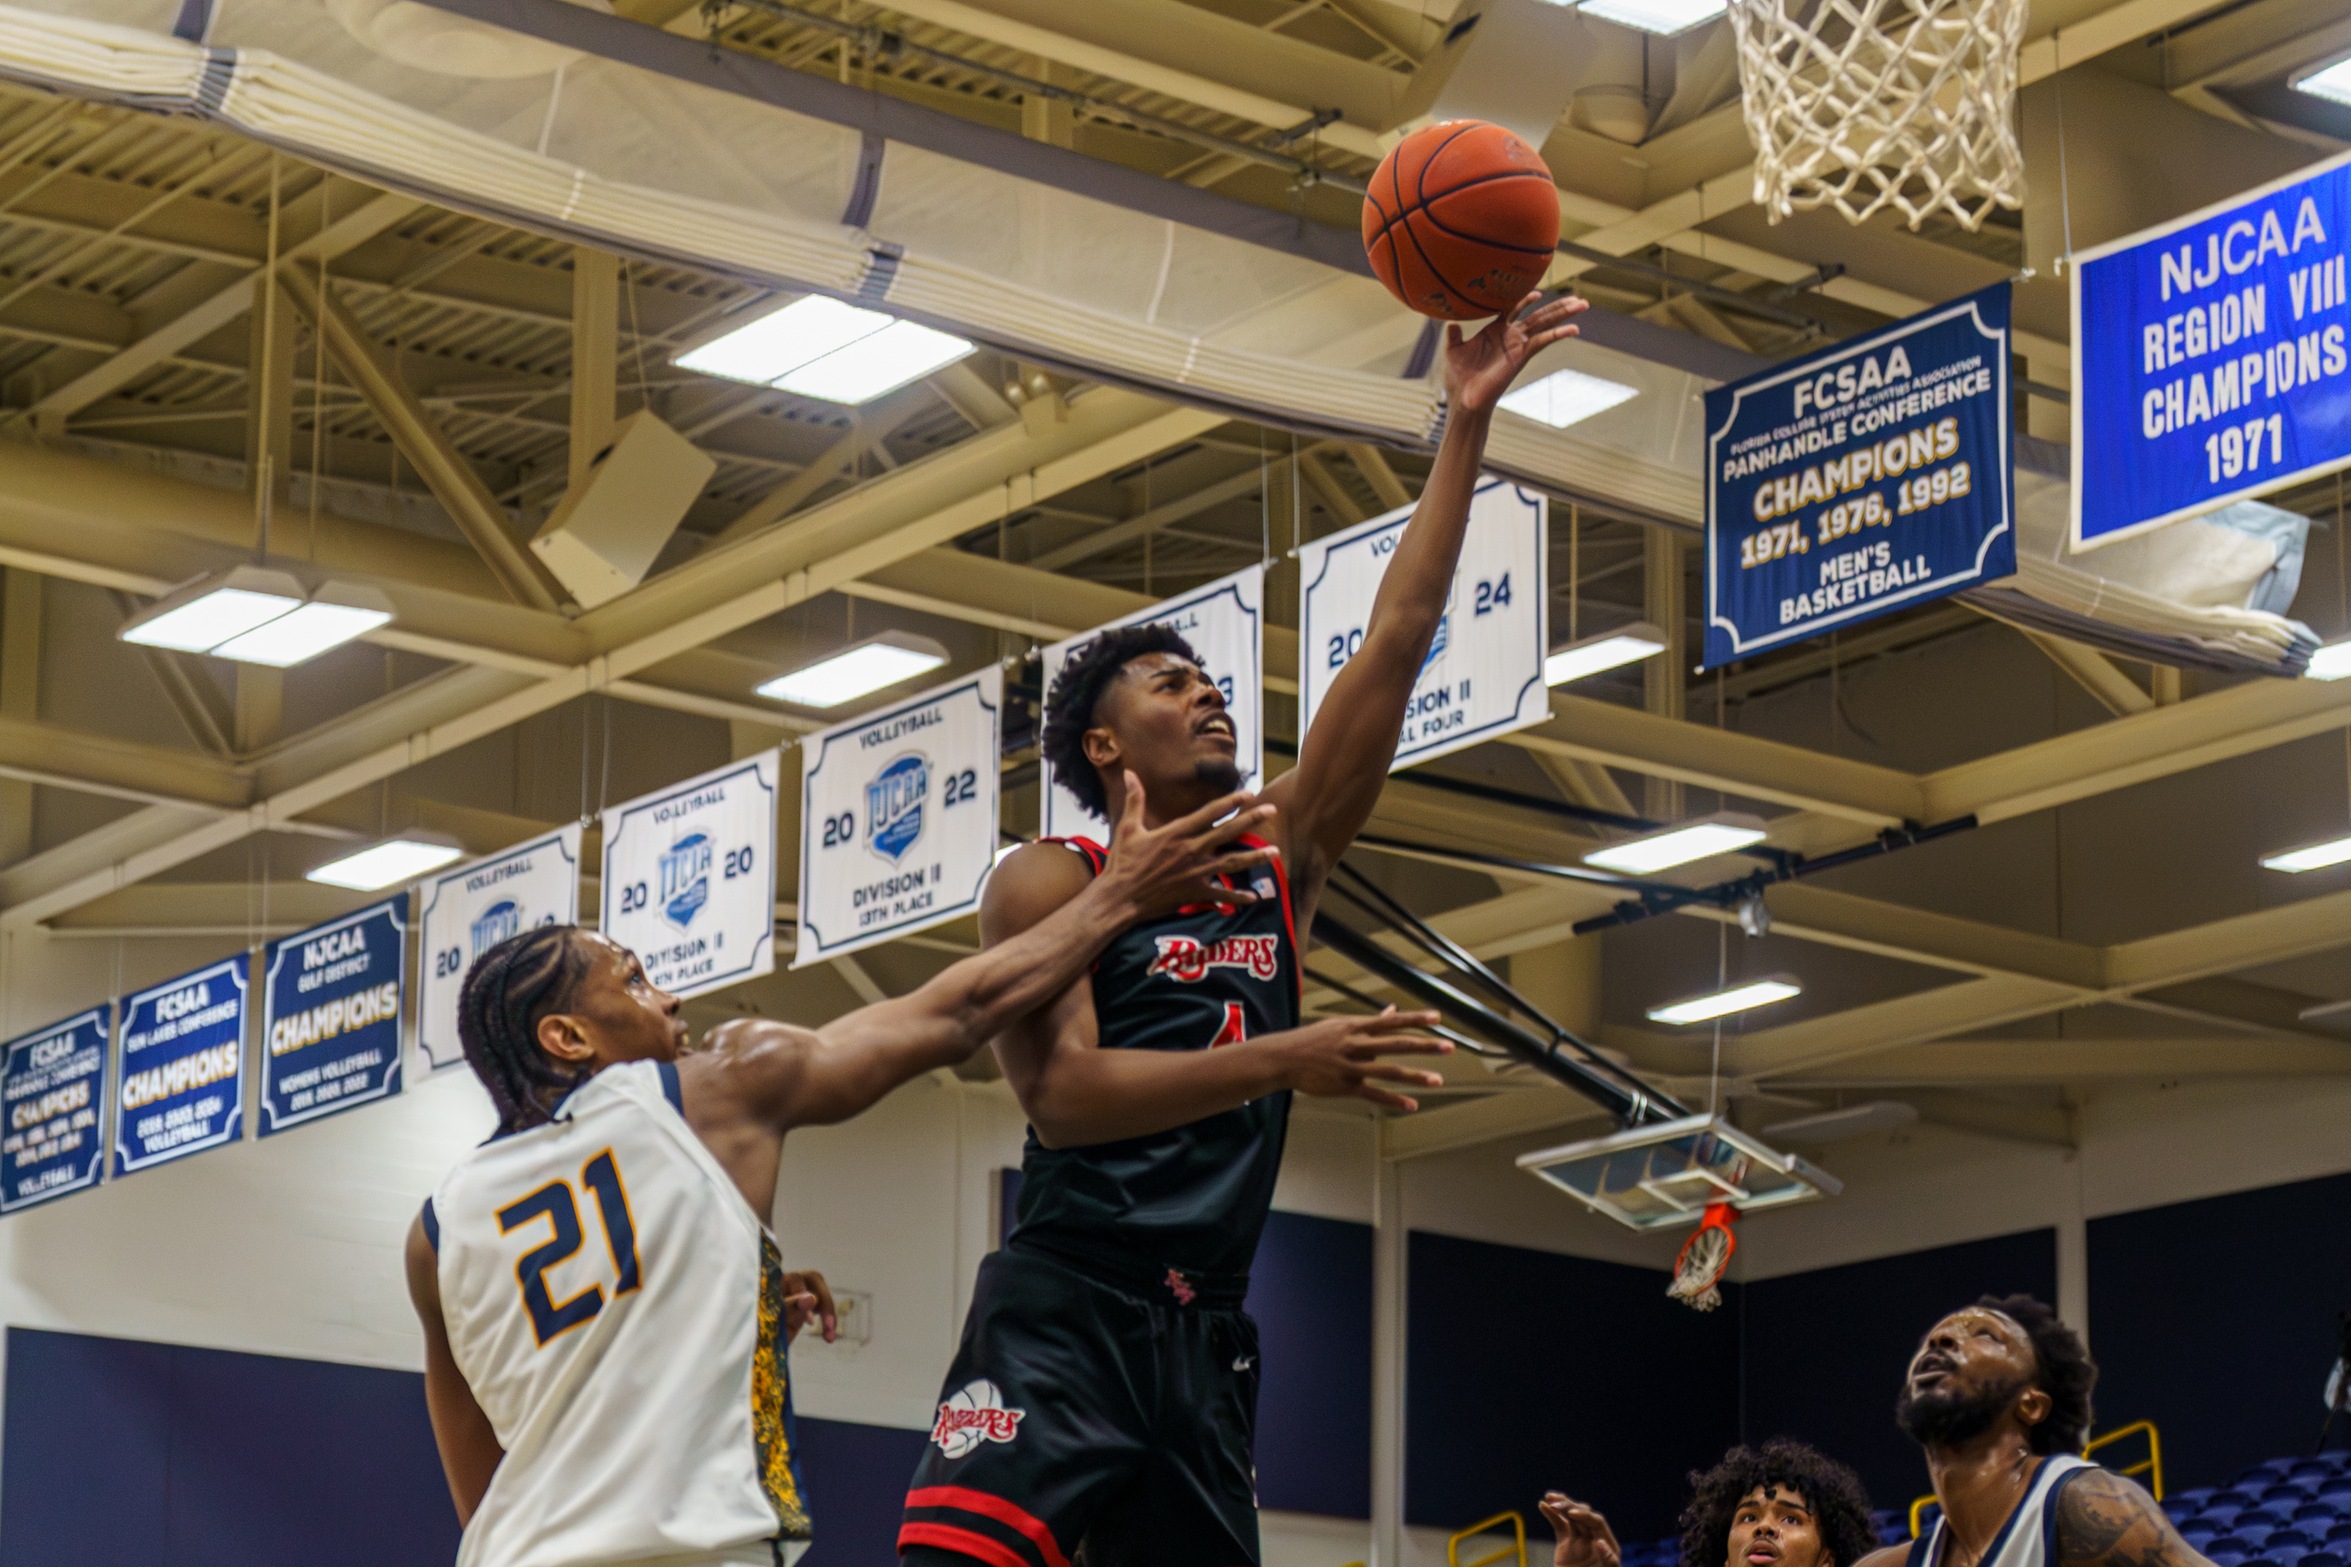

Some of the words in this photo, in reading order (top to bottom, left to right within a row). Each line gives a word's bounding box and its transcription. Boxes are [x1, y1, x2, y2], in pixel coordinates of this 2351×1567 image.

[2160, 197, 2326, 302] NJCAA
[2143, 284, 2266, 374] REGION
[2289, 253, 2346, 321] VIII
[1794, 346, 1912, 419] FCSAA
[2142, 325, 2348, 439] CHAMPIONS
[1723, 421, 1847, 483] PANHANDLE
[1851, 367, 1991, 436] CONFERENCE
[1754, 418, 1958, 522] CHAMPIONS
[2205, 413, 2283, 484] 1971
[1741, 520, 1809, 569] 1971,
[1818, 492, 1892, 542] 1976,
[1897, 462, 1971, 516] 1992
[1820, 541, 1891, 587] MEN'S
[1475, 571, 1512, 616] 24
[1779, 555, 1931, 625] BASKETBALL
[1329, 627, 1363, 669] 20
[1406, 687, 1450, 720] SION
[1460, 679, 1471, 700] II
[860, 707, 943, 749] VOLLEYBALL
[1423, 710, 1464, 735] FOUR
[653, 788, 725, 825] VOLLEYBALL
[944, 769, 976, 809] 22
[823, 812, 854, 848] 20
[465, 857, 533, 894] VOLLEYBALL
[724, 845, 754, 880] 20
[620, 881, 648, 915] 20
[853, 869, 925, 908] DIVISION
[931, 863, 942, 883] II
[893, 892, 934, 915] PLACE
[303, 924, 366, 972] NJCAA
[435, 946, 461, 980] 20
[645, 938, 706, 971] DIVISION
[677, 958, 714, 979] PLACE
[155, 981, 210, 1024] FCSAA
[270, 980, 398, 1057] CHAMPIONS
[122, 1039, 238, 1111] CHAMPIONS
[144, 1118, 210, 1154] VOLLEYBALL
[493, 1145, 643, 1351] 21
